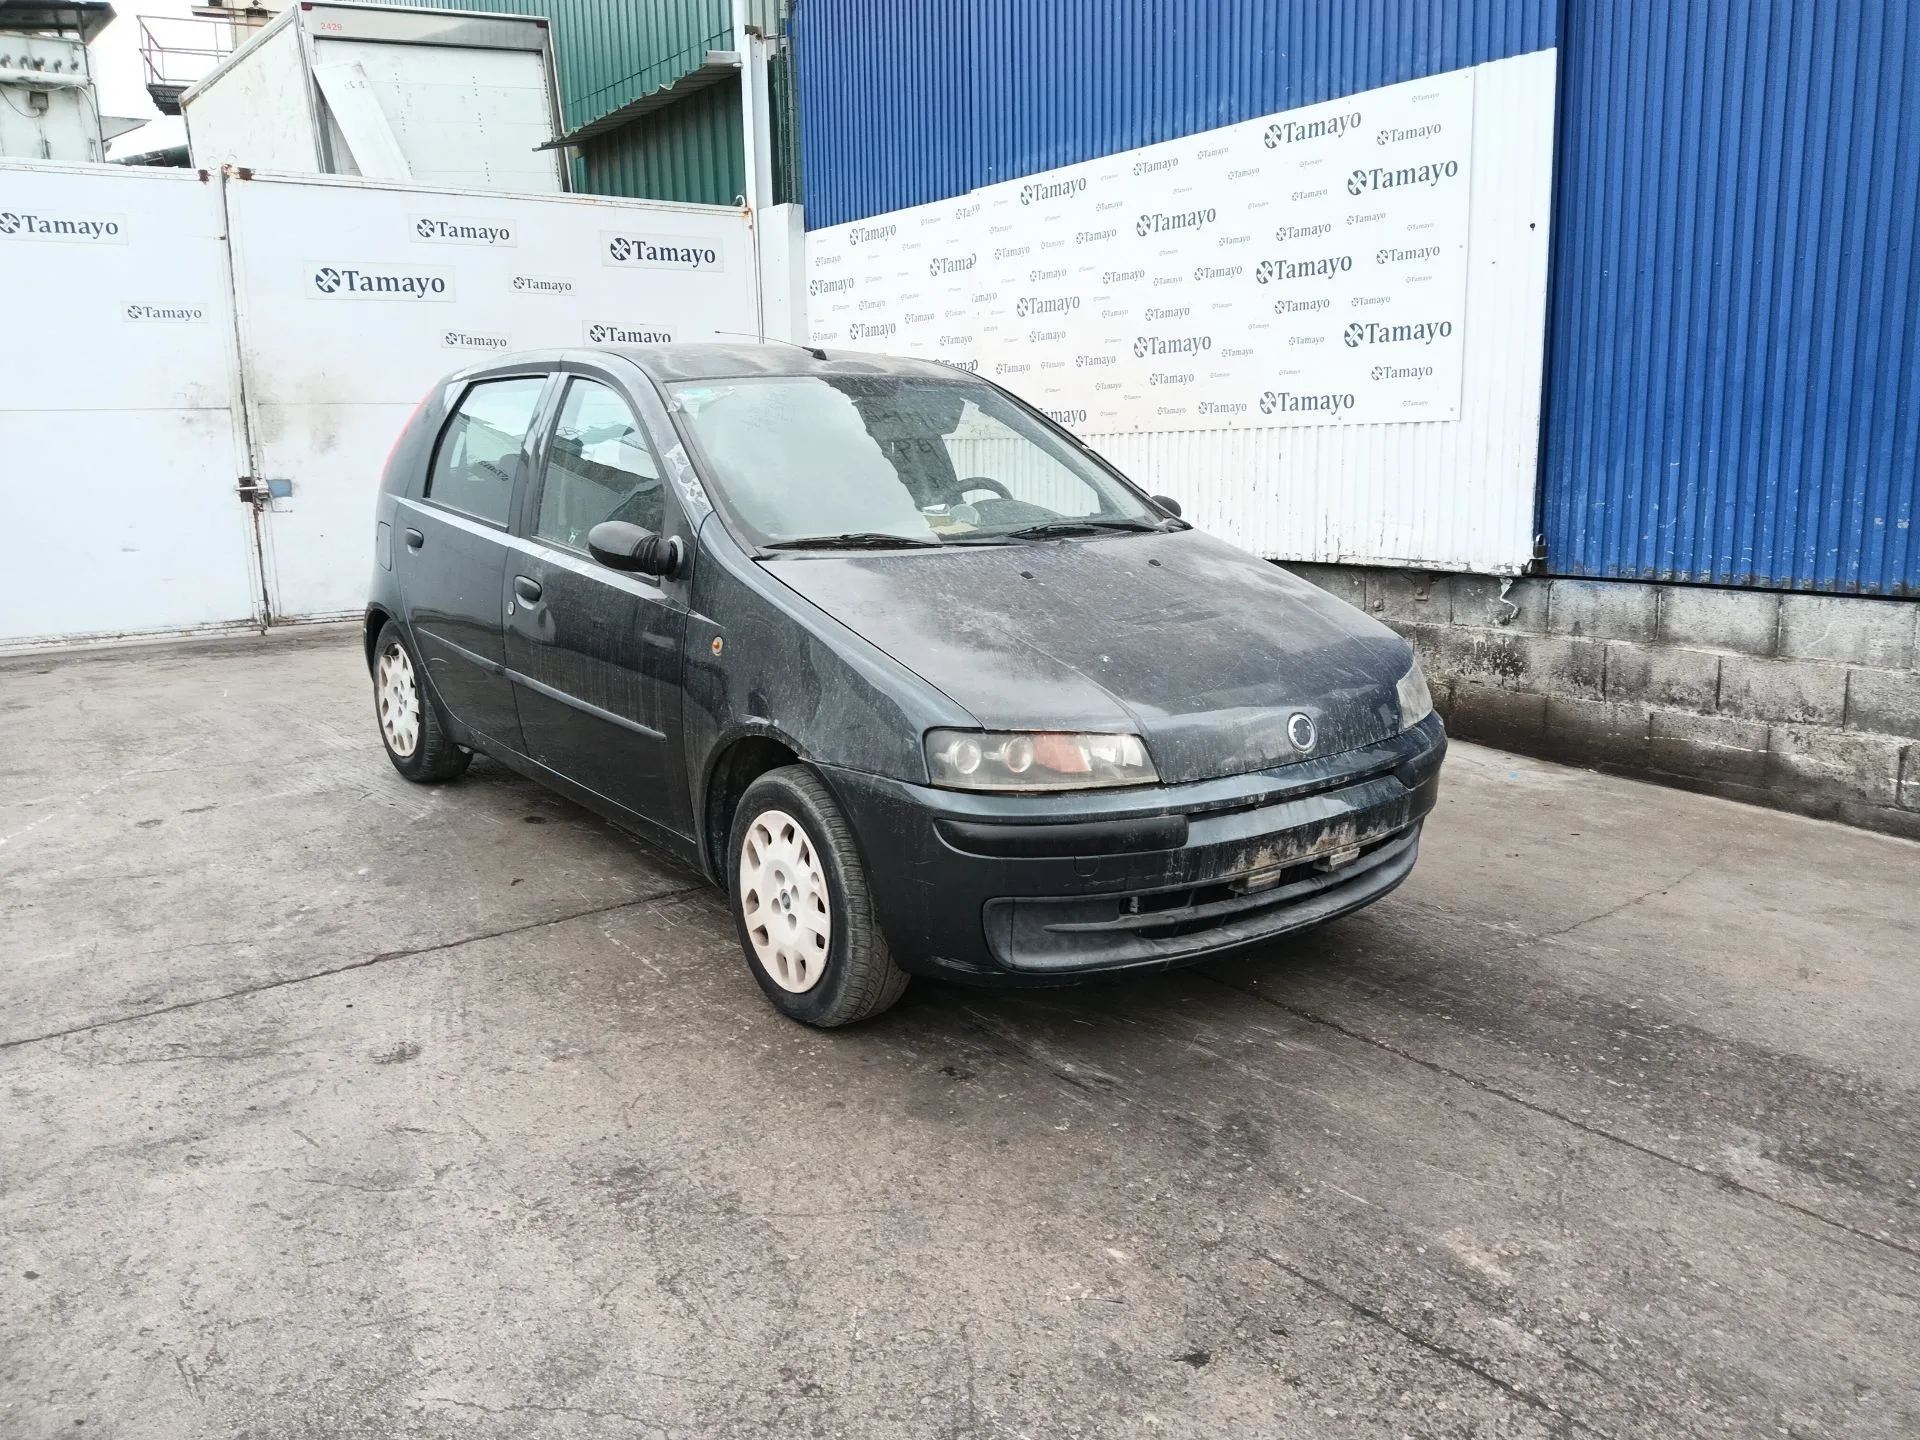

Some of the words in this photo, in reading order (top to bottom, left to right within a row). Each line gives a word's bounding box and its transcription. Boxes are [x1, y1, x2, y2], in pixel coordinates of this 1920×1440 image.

[321, 23, 342, 31] 2429
[1284, 112, 1361, 143] Tamayo
[1389, 123, 1441, 142] Tamayo
[1204, 147, 1228, 158] Tamayo
[1143, 157, 1178, 173] Tamayo
[1235, 168, 1259, 178] Tamayo
[1369, 160, 1458, 190] Tamayo
[1034, 178, 1086, 201] Tamayo
[1299, 188, 1327, 199] Tamayo
[1152, 208, 1216, 232] Tamayo
[1354, 212, 1386, 223] Tamayo
[22, 215, 118, 239] Tamayo
[436, 222, 509, 243] Tamayo
[859, 225, 896, 242] Tamayo
[1288, 223, 1331, 239] Tamayo
[1084, 229, 1116, 242] Tamayo
[1225, 236, 1250, 245] Tamayo
[632, 241, 715, 268] Tamayo
[1002, 246, 1030, 258] Tamayo
[1389, 246, 1440, 261] Tamayo
[1037, 269, 1066, 280] Tamayo
[1204, 266, 1242, 279] Tamayo
[1274, 256, 1352, 279] Tamayo
[1111, 269, 1145, 283] Tamayo
[1160, 277, 1182, 285] Tamayo
[342, 271, 445, 298] Tamayo
[525, 278, 571, 293] Tamayo
[818, 278, 854, 294] Tamayo
[1030, 296, 1080, 315] Tamayo
[1286, 298, 1330, 312] Tamayo
[1359, 296, 1390, 305] Tamayo
[143, 307, 201, 321] Tamayo
[912, 313, 934, 322] Tamayo
[1154, 307, 1189, 319] Tamayo
[859, 323, 896, 339] Tamayo
[1037, 330, 1066, 342] Tamayo
[1366, 320, 1452, 344] Tamayo
[458, 334, 507, 349] Tamayo
[946, 336, 972, 345] Tamayo
[1148, 336, 1211, 357] Tamayo
[1296, 336, 1324, 345] Tamayo
[1228, 348, 1253, 357] Tamayo
[1084, 355, 1116, 367] Tamayo
[1003, 363, 1030, 374] Tamayo
[1384, 366, 1432, 379] Tamayo
[1158, 374, 1194, 385] Tamayo
[1208, 403, 1247, 415] Tamayo
[1278, 392, 1354, 415] Tamayo
